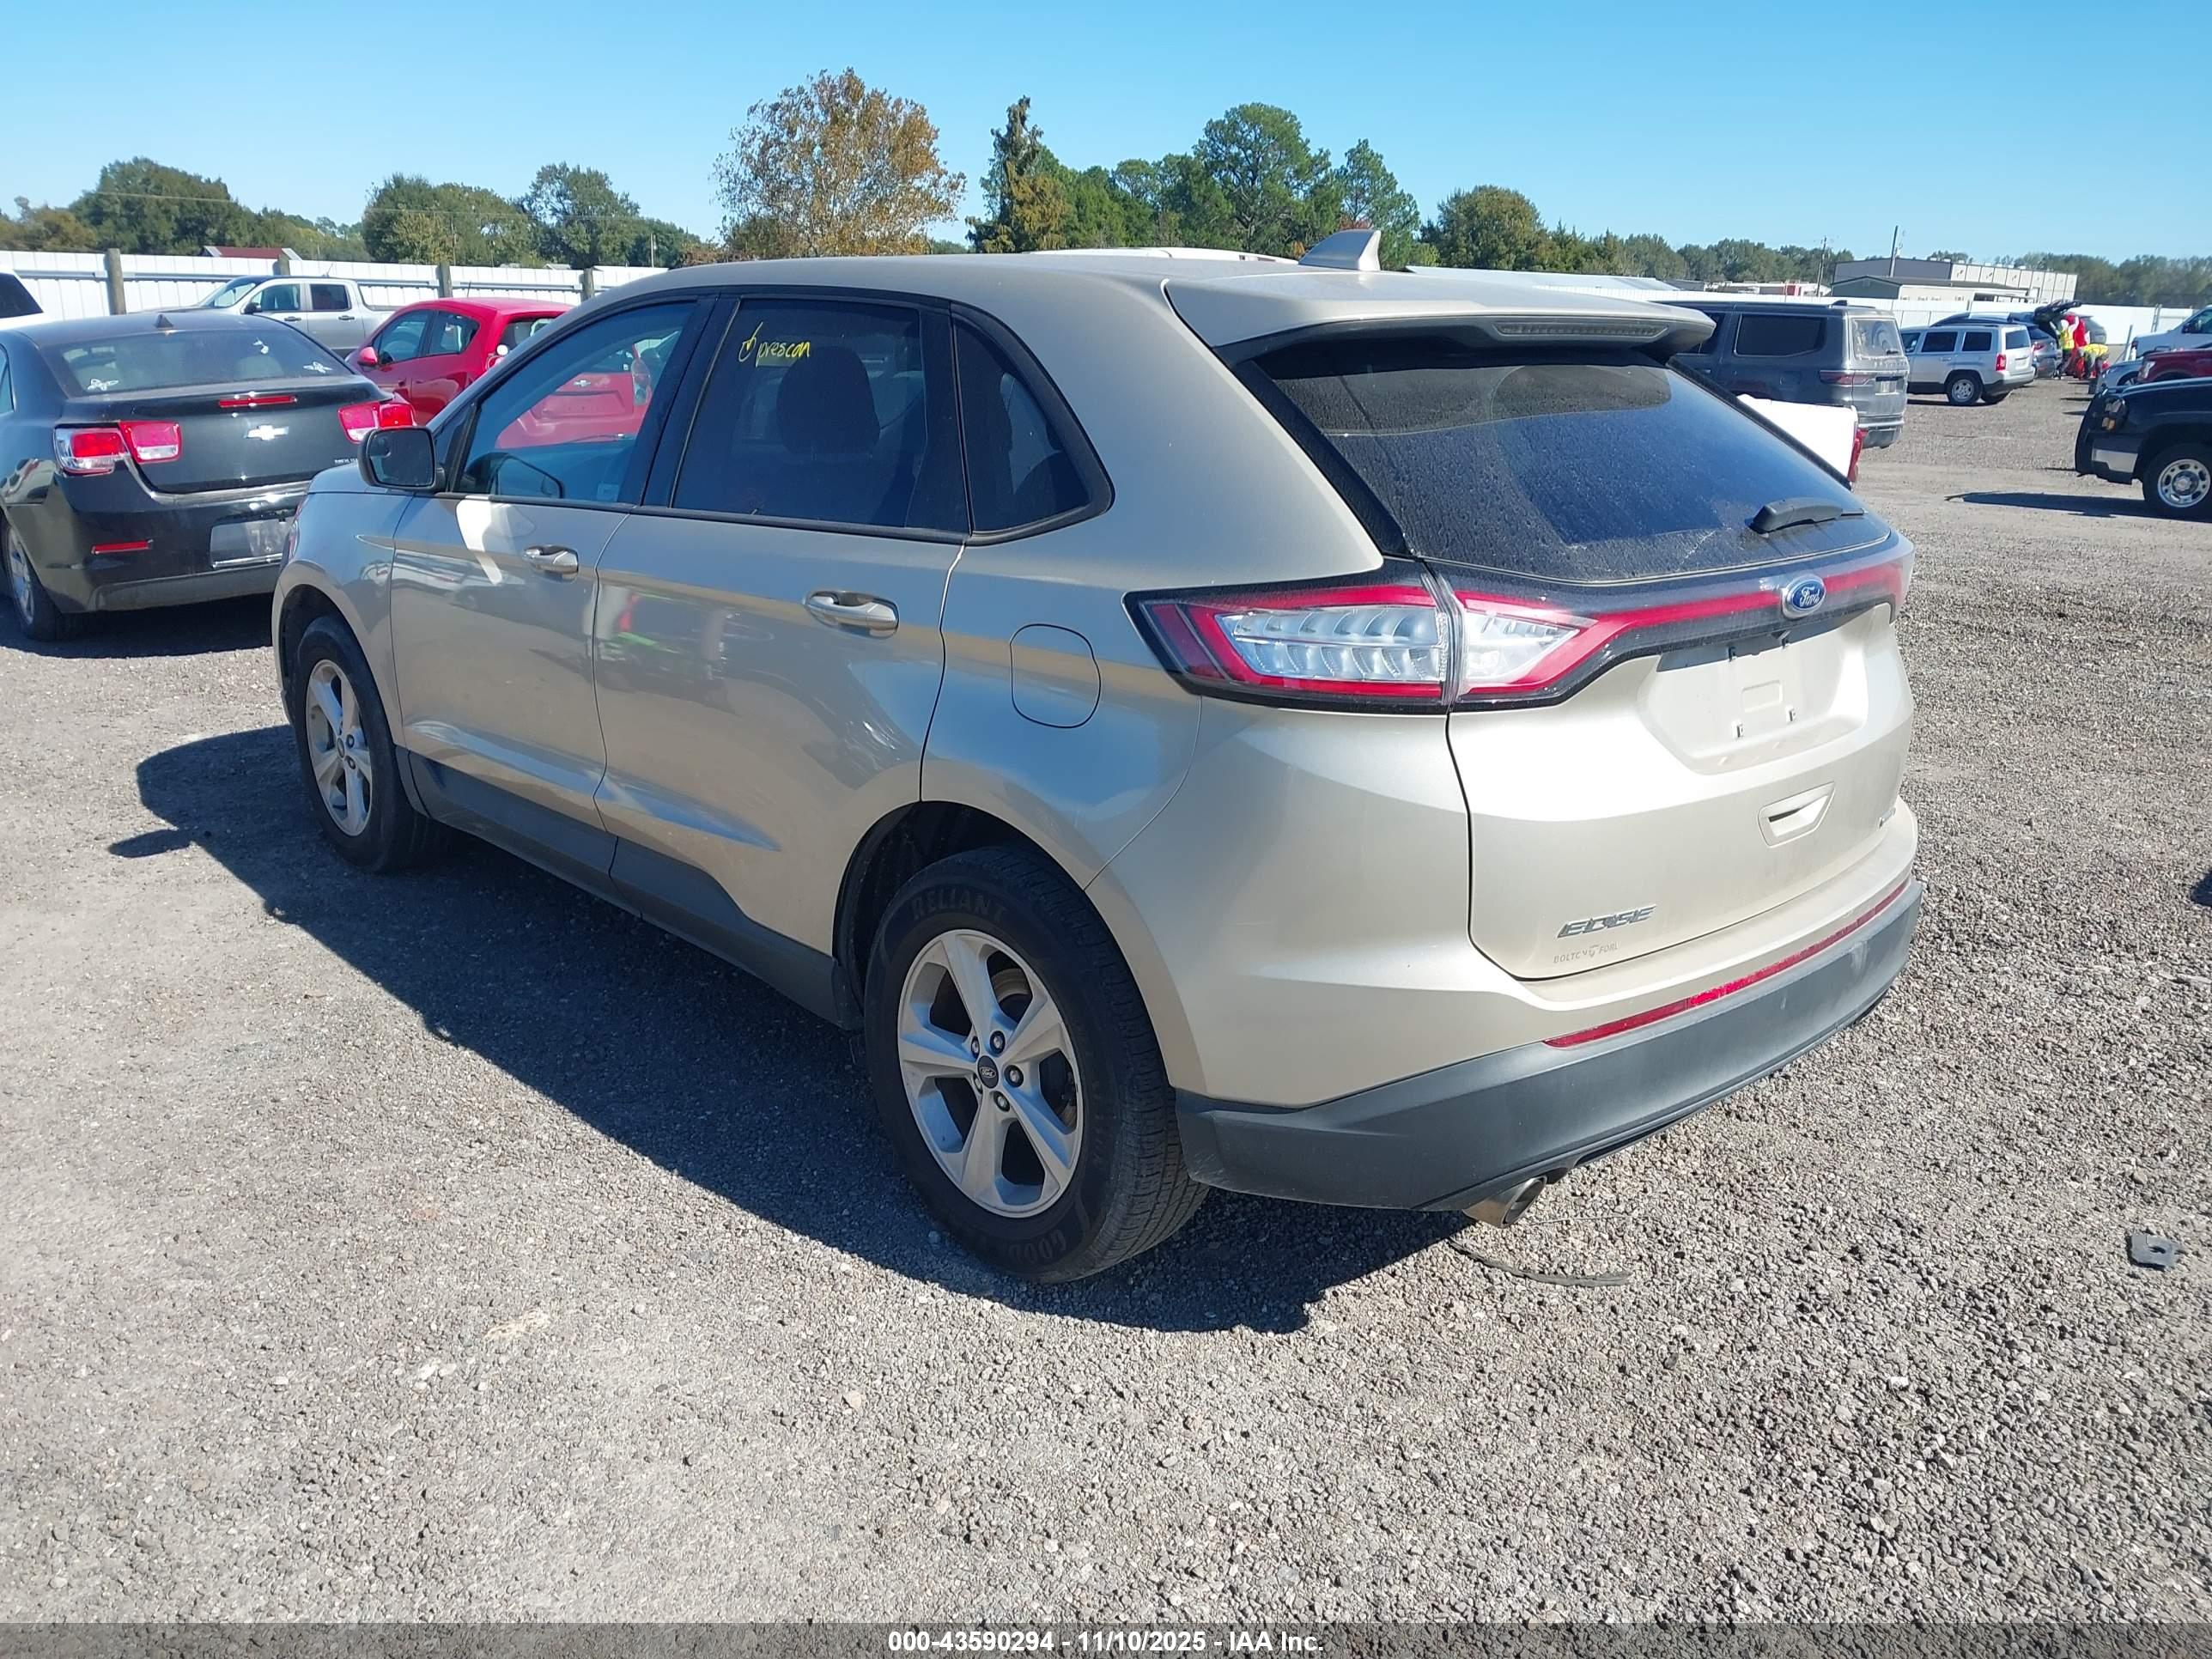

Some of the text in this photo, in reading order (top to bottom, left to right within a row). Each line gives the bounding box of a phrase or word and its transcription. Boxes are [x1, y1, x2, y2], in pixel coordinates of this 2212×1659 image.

[1799, 586, 1820, 608] Ford
[911, 887, 1009, 924] RELIANT
[1557, 904, 1657, 938] EDGE
